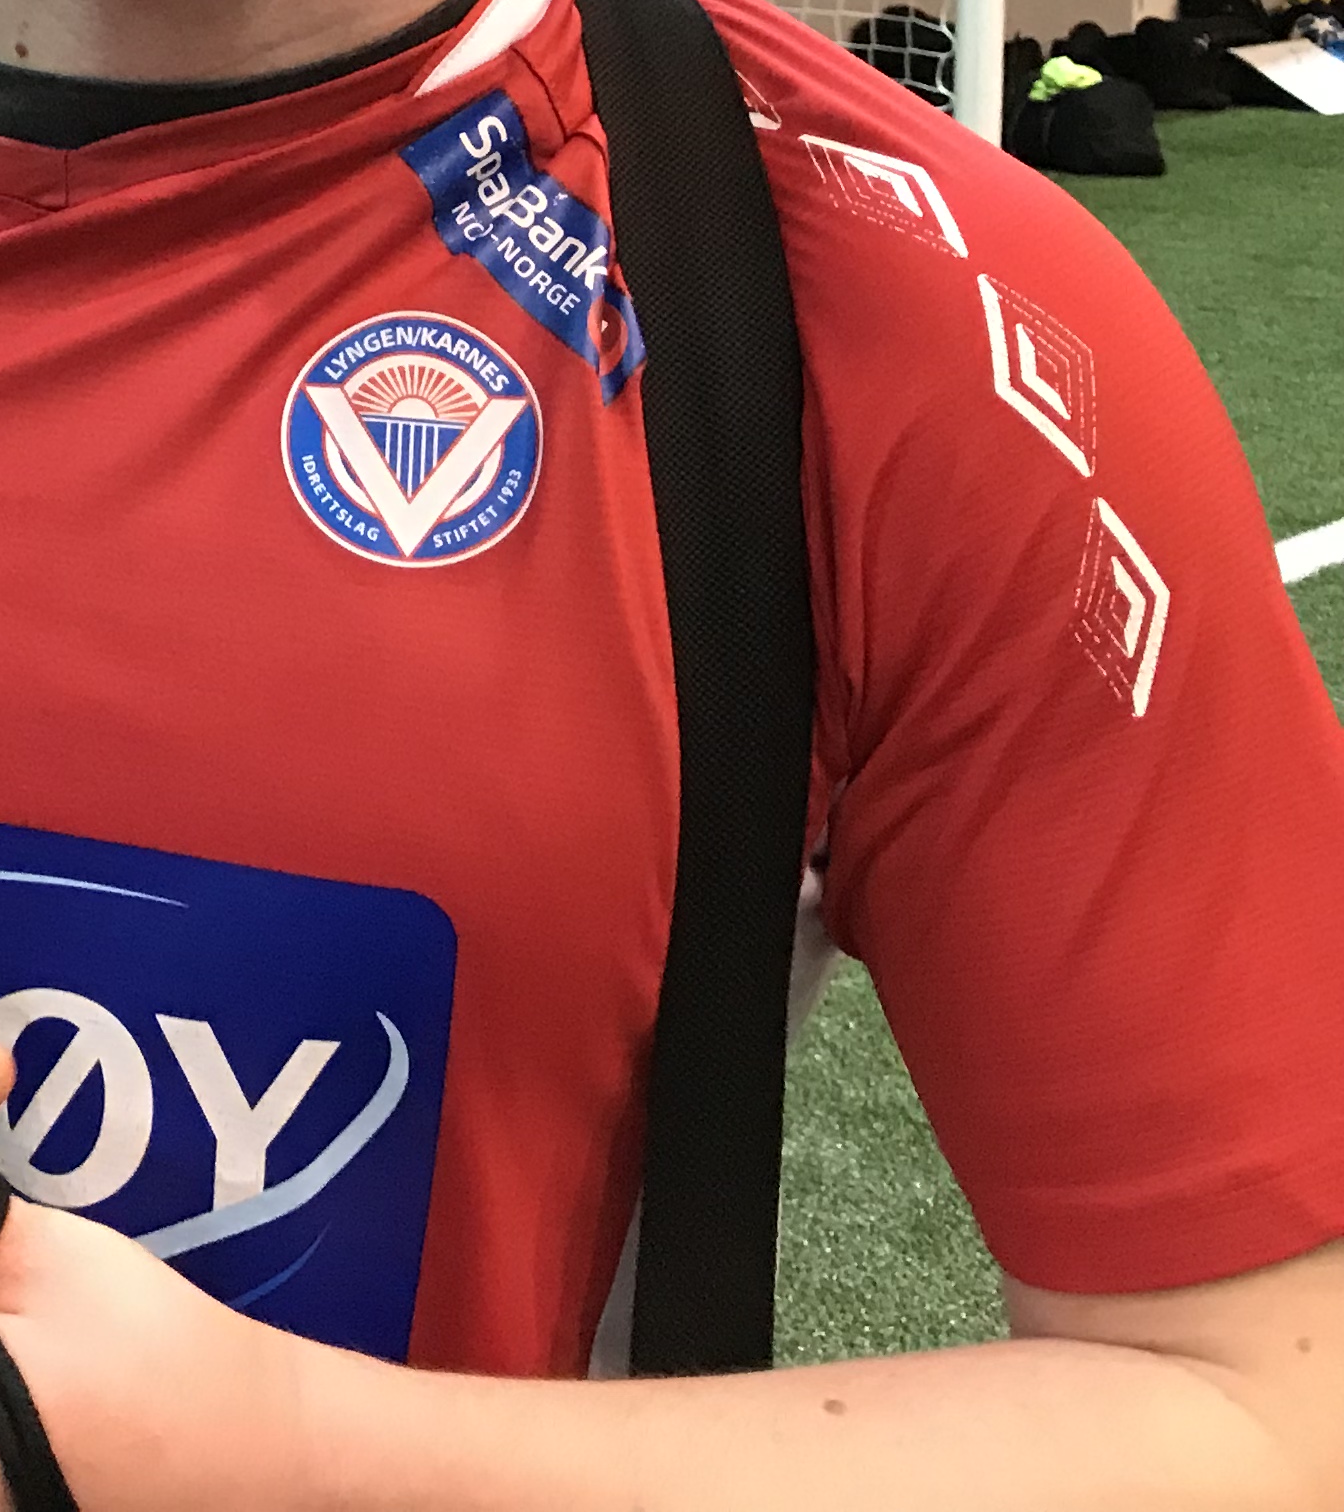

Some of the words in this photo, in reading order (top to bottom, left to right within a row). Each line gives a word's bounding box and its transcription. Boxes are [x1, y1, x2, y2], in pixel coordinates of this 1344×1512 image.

[323, 326, 510, 393] LYNGEN/KARNES
[301, 454, 380, 542] IDRETTSLAG
[432, 506, 499, 548] STIFTET
[497, 469, 522, 505] 1933
